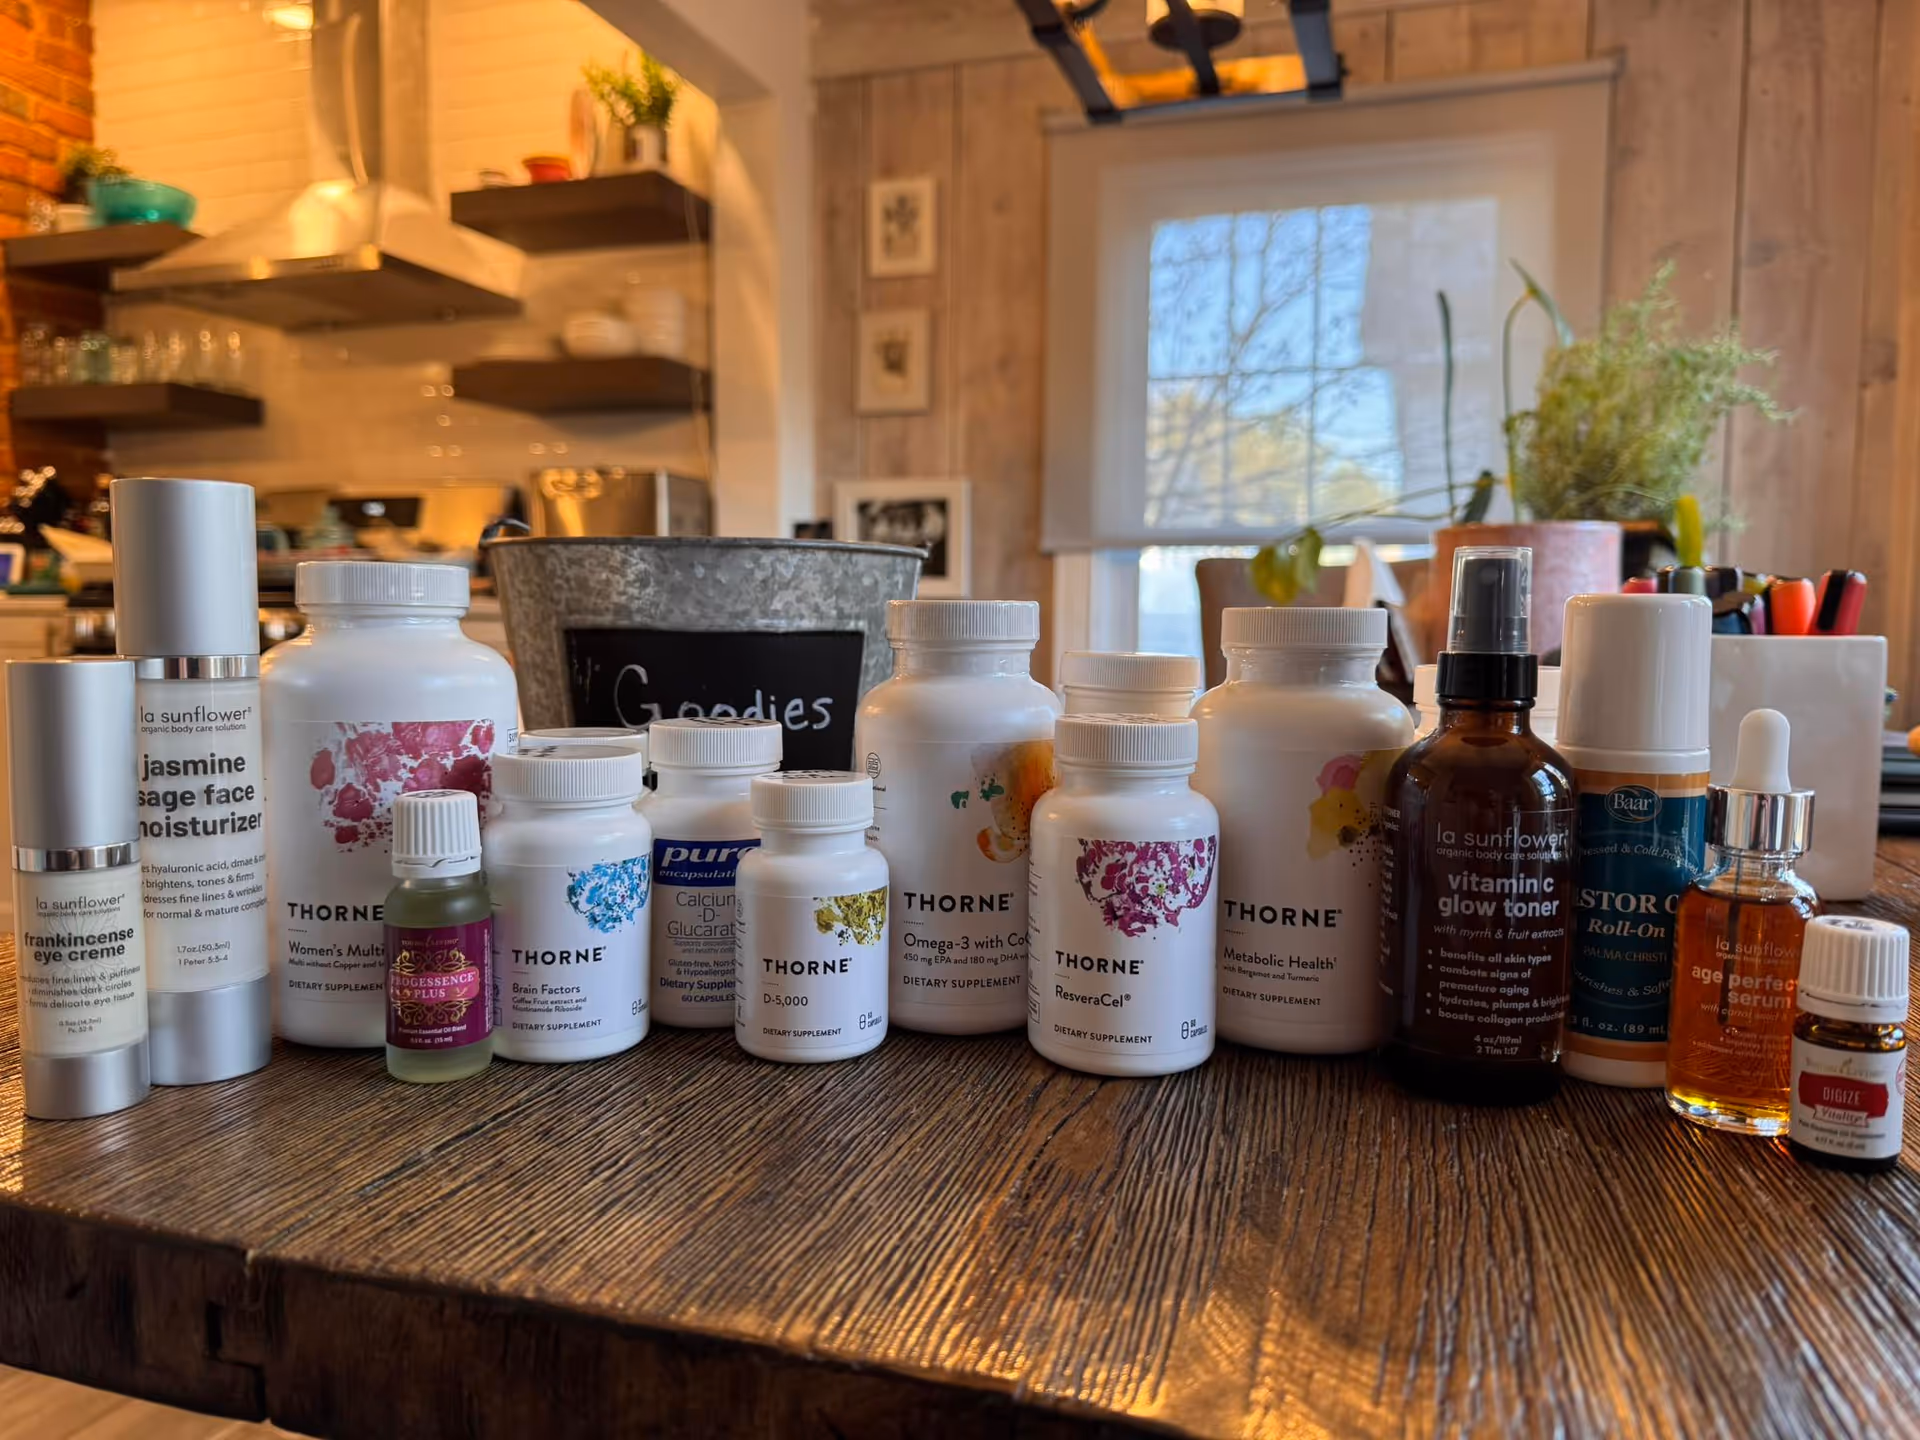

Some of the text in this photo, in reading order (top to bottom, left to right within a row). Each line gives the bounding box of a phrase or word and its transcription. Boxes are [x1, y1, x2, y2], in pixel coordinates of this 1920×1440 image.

[140, 705, 155, 723] la
[141, 723, 247, 735] organic body care solutions
[142, 752, 246, 782] jasmine
[137, 784, 255, 813] sage face
[1614, 793, 1652, 811] Baar
[1437, 822, 1456, 844] la
[1436, 847, 1563, 861] organic body care solutions
[1621, 843, 1659, 857] & Cold
[151, 863, 204, 875] hyaluronic
[206, 860, 229, 872] acid,
[659, 869, 736, 880] encapsulati
[146, 872, 255, 891] brightens, tones & firms
[1448, 870, 1539, 894] vitamin
[36, 896, 48, 910] la
[180, 889, 235, 904] fine lines &
[904, 892, 1010, 913] THORNE
[1577, 889, 1658, 914] STOR
[143, 905, 240, 919] for normal & mature
[287, 902, 384, 921] THORNE
[1223, 900, 1337, 928] THORNE
[1438, 894, 1560, 918] glow toner
[667, 921, 735, 937] Glucarat
[1433, 924, 1565, 940] with myrrh & fruit extracts
[1588, 918, 1666, 938] Roll-On
[24, 928, 134, 948] frankincense
[904, 933, 1003, 955] Omega-3 with
[1716, 935, 1798, 958] la sunflow
[34, 943, 125, 965] eye creme
[288, 940, 384, 957] Women's Multi
[512, 947, 604, 966] THORNE
[1223, 946, 1284, 967] Metabolic
[1440, 947, 1552, 966] benefits all skin types
[1584, 945, 1667, 962] PALMA CHRISTI
[183, 957, 206, 966] Peter
[306, 960, 332, 969] without
[333, 960, 361, 971] Copper
[362, 961, 376, 969] and
[762, 958, 849, 975] THORNE
[904, 953, 1019, 966] 450 mg EPA and 180 mg DHA
[1055, 950, 1140, 975] THORNE
[73, 973, 96, 984] lines
[99, 971, 107, 981] &
[391, 970, 476, 988] PROGESSENCE
[1223, 965, 1319, 982] with Bergamot and Turmeric
[1439, 964, 1533, 981] combats signs of
[1692, 966, 1723, 984] age
[32, 980, 132, 997] diminishes dark circles
[288, 980, 384, 992] DIETARY SUPPLEMEN
[512, 982, 581, 995] Brain Factors
[660, 977, 736, 991] Dietary Supple
[904, 975, 1021, 989] DIETARY SUPPLEMENT
[1439, 980, 1530, 997] premature aging
[50, 991, 135, 1009] delicate eye tissue
[414, 988, 446, 999] PLUS
[693, 993, 736, 1002] CAPSULES
[763, 993, 808, 1007] D-5,000
[1222, 986, 1321, 1006] DIETARY SUPPLEMENT
[1627, 987, 1640, 997] &
[1728, 991, 1792, 1010] serum
[555, 1004, 582, 1012] Riboside
[1438, 993, 1539, 1011] hydrates, plumps &
[1701, 1002, 1719, 1014] with
[512, 1019, 602, 1031] DIETARY SUPPLEMENT
[1438, 1008, 1523, 1027] boosts collagen
[763, 1027, 842, 1037] DIETARY SUPPLEMENT
[1054, 1024, 1152, 1044] DIETARY SUPPLEMENT
[1598, 1022, 1618, 1032] oz.
[1623, 1022, 1645, 1034] (89
[1476, 1045, 1502, 1055] 2 Tim
[1823, 1086, 1860, 1106] DIGIZE
